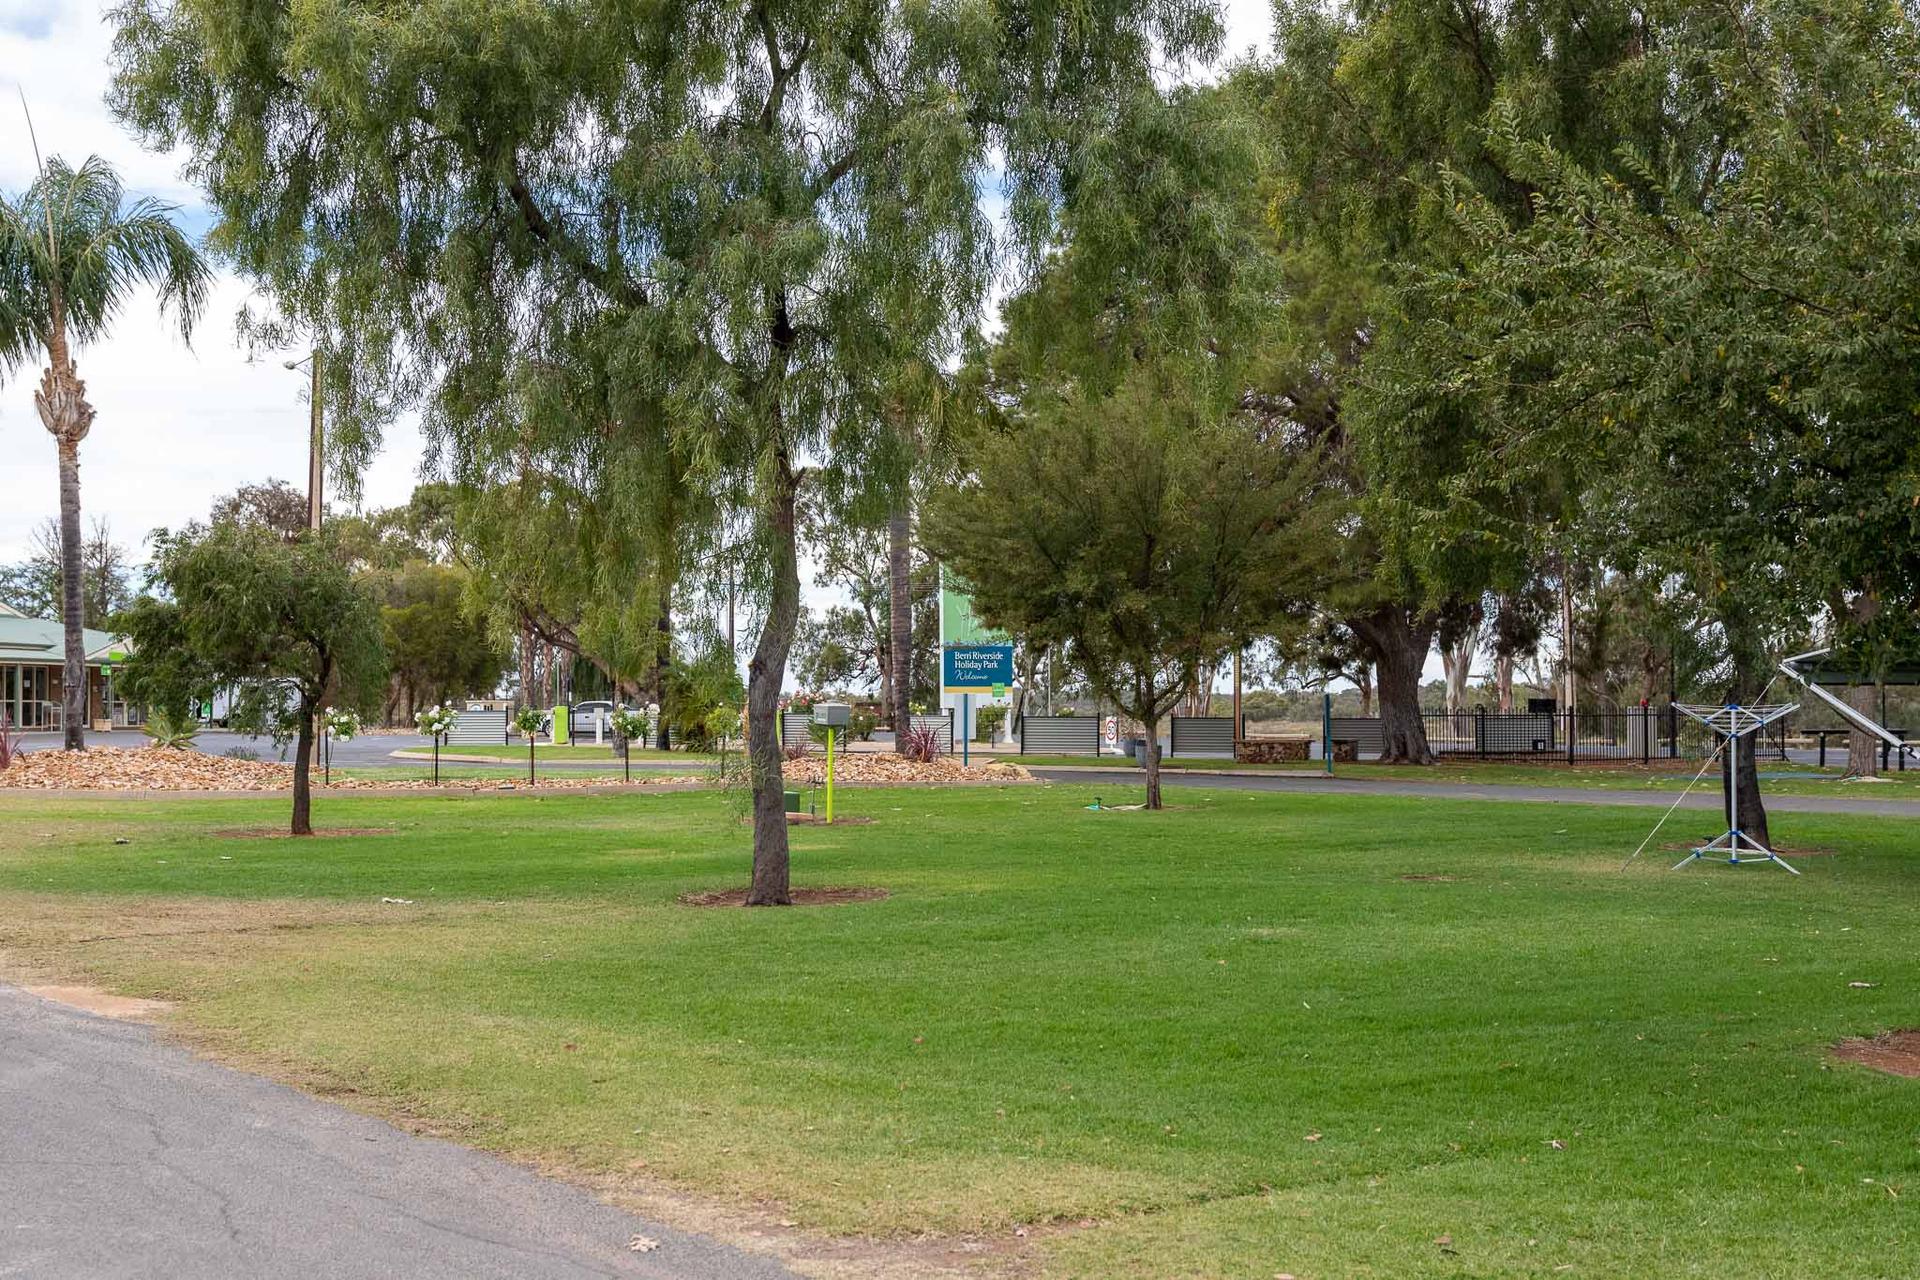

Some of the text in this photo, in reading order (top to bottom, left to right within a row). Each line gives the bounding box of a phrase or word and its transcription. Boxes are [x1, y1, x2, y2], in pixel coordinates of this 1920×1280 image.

[954, 651, 1003, 660] Berri Riverside
[954, 660, 998, 670] Holiday Park
[953, 669, 989, 680] Welcome
